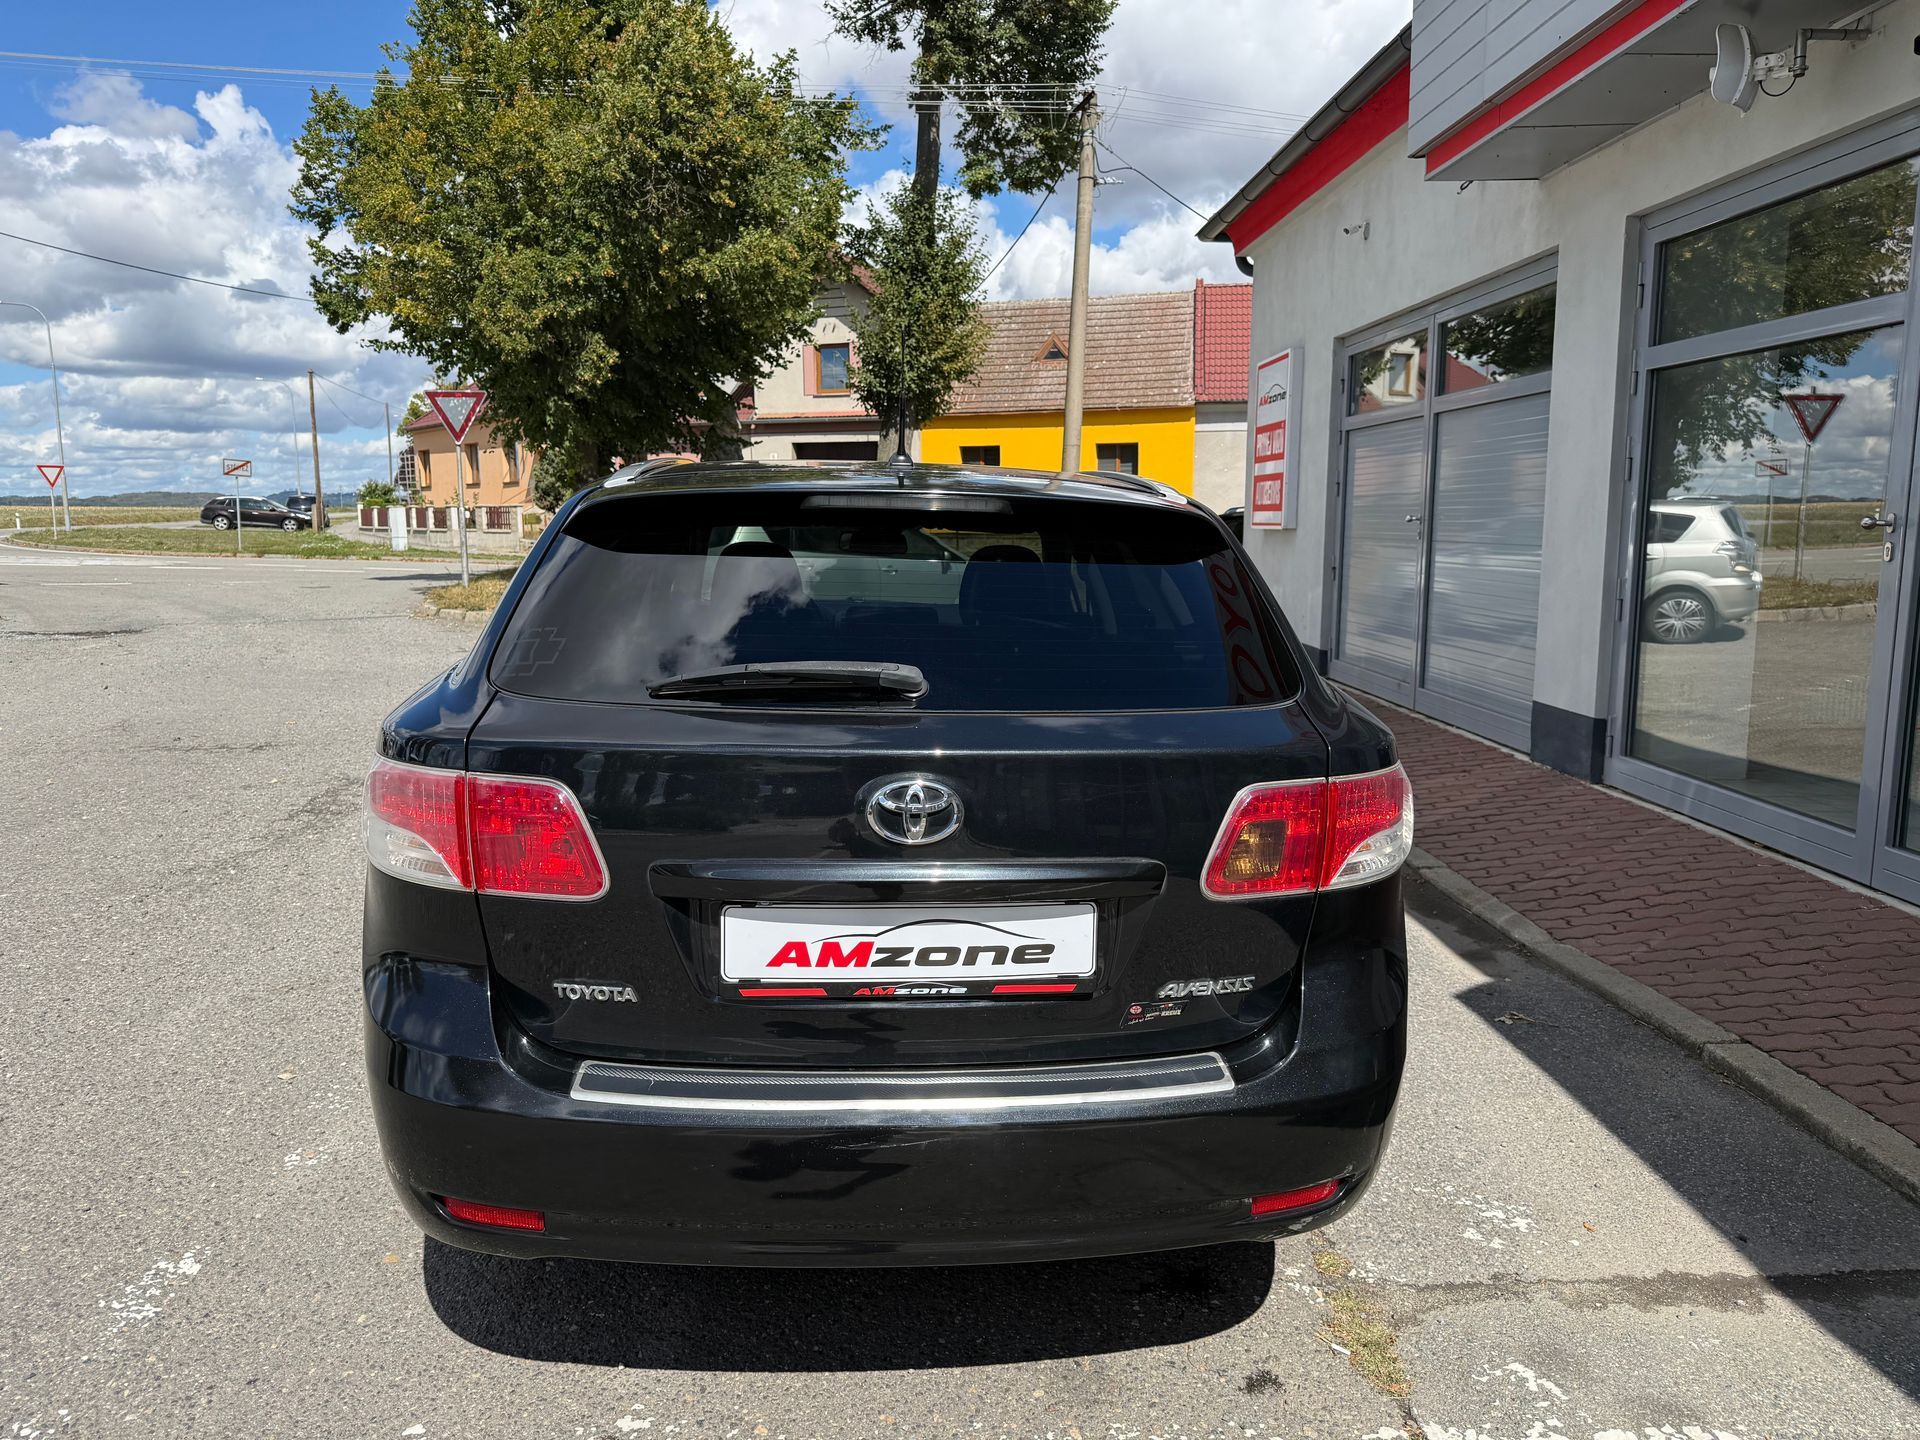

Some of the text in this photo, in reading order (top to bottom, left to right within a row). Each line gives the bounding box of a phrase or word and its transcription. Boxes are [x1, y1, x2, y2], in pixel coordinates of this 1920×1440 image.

[1259, 391, 1287, 407] AMzone
[765, 940, 1056, 968] AMzone
[553, 982, 638, 1003] TOYOTA
[853, 985, 967, 996] AMzone
[1157, 976, 1256, 999] AVENSIS
